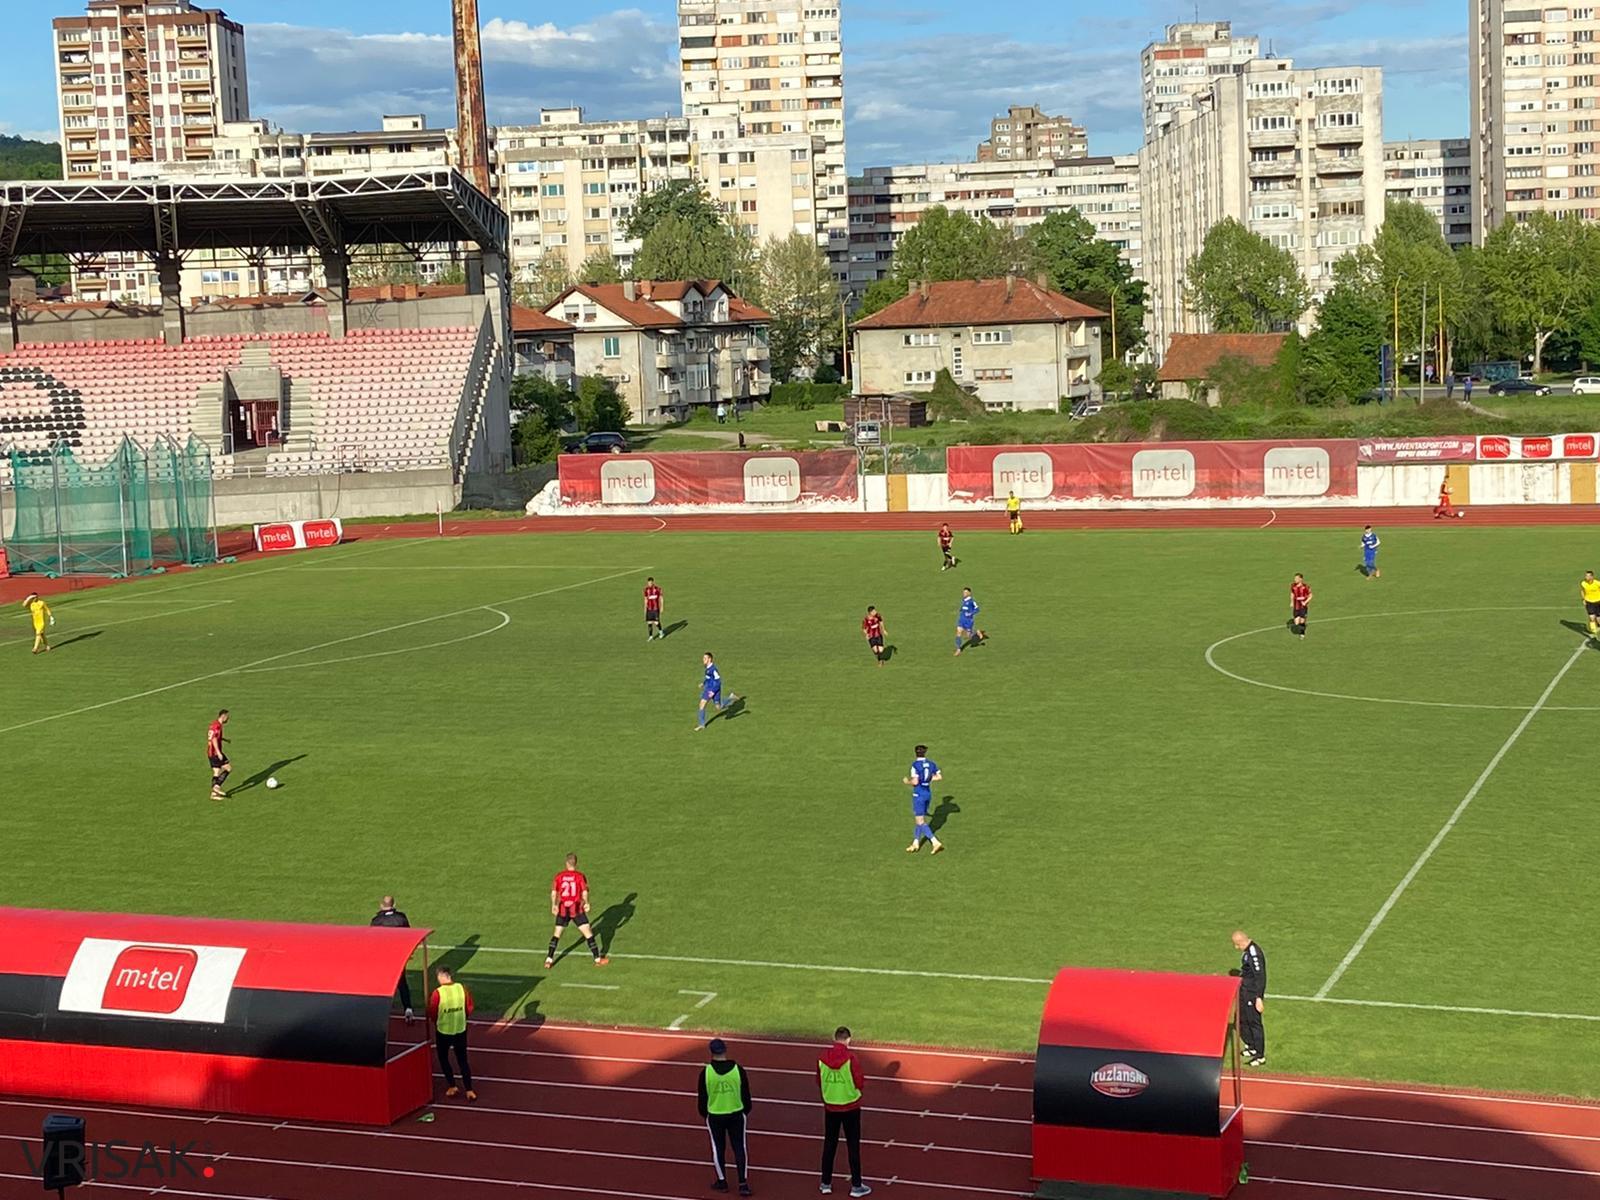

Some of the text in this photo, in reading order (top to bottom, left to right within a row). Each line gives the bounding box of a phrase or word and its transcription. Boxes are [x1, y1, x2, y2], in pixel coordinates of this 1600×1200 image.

[1566, 440, 1591, 450] m:tel
[750, 470, 793, 487] m:tel
[1000, 465, 1046, 483] m:tel
[1139, 462, 1187, 481] m:tel
[1271, 461, 1321, 480] m:tel
[607, 473, 648, 489] m:tel
[262, 530, 292, 543] m:tel
[306, 527, 335, 540] m:tel
[561, 881, 577, 897] 21
[115, 964, 184, 991] m:tel
